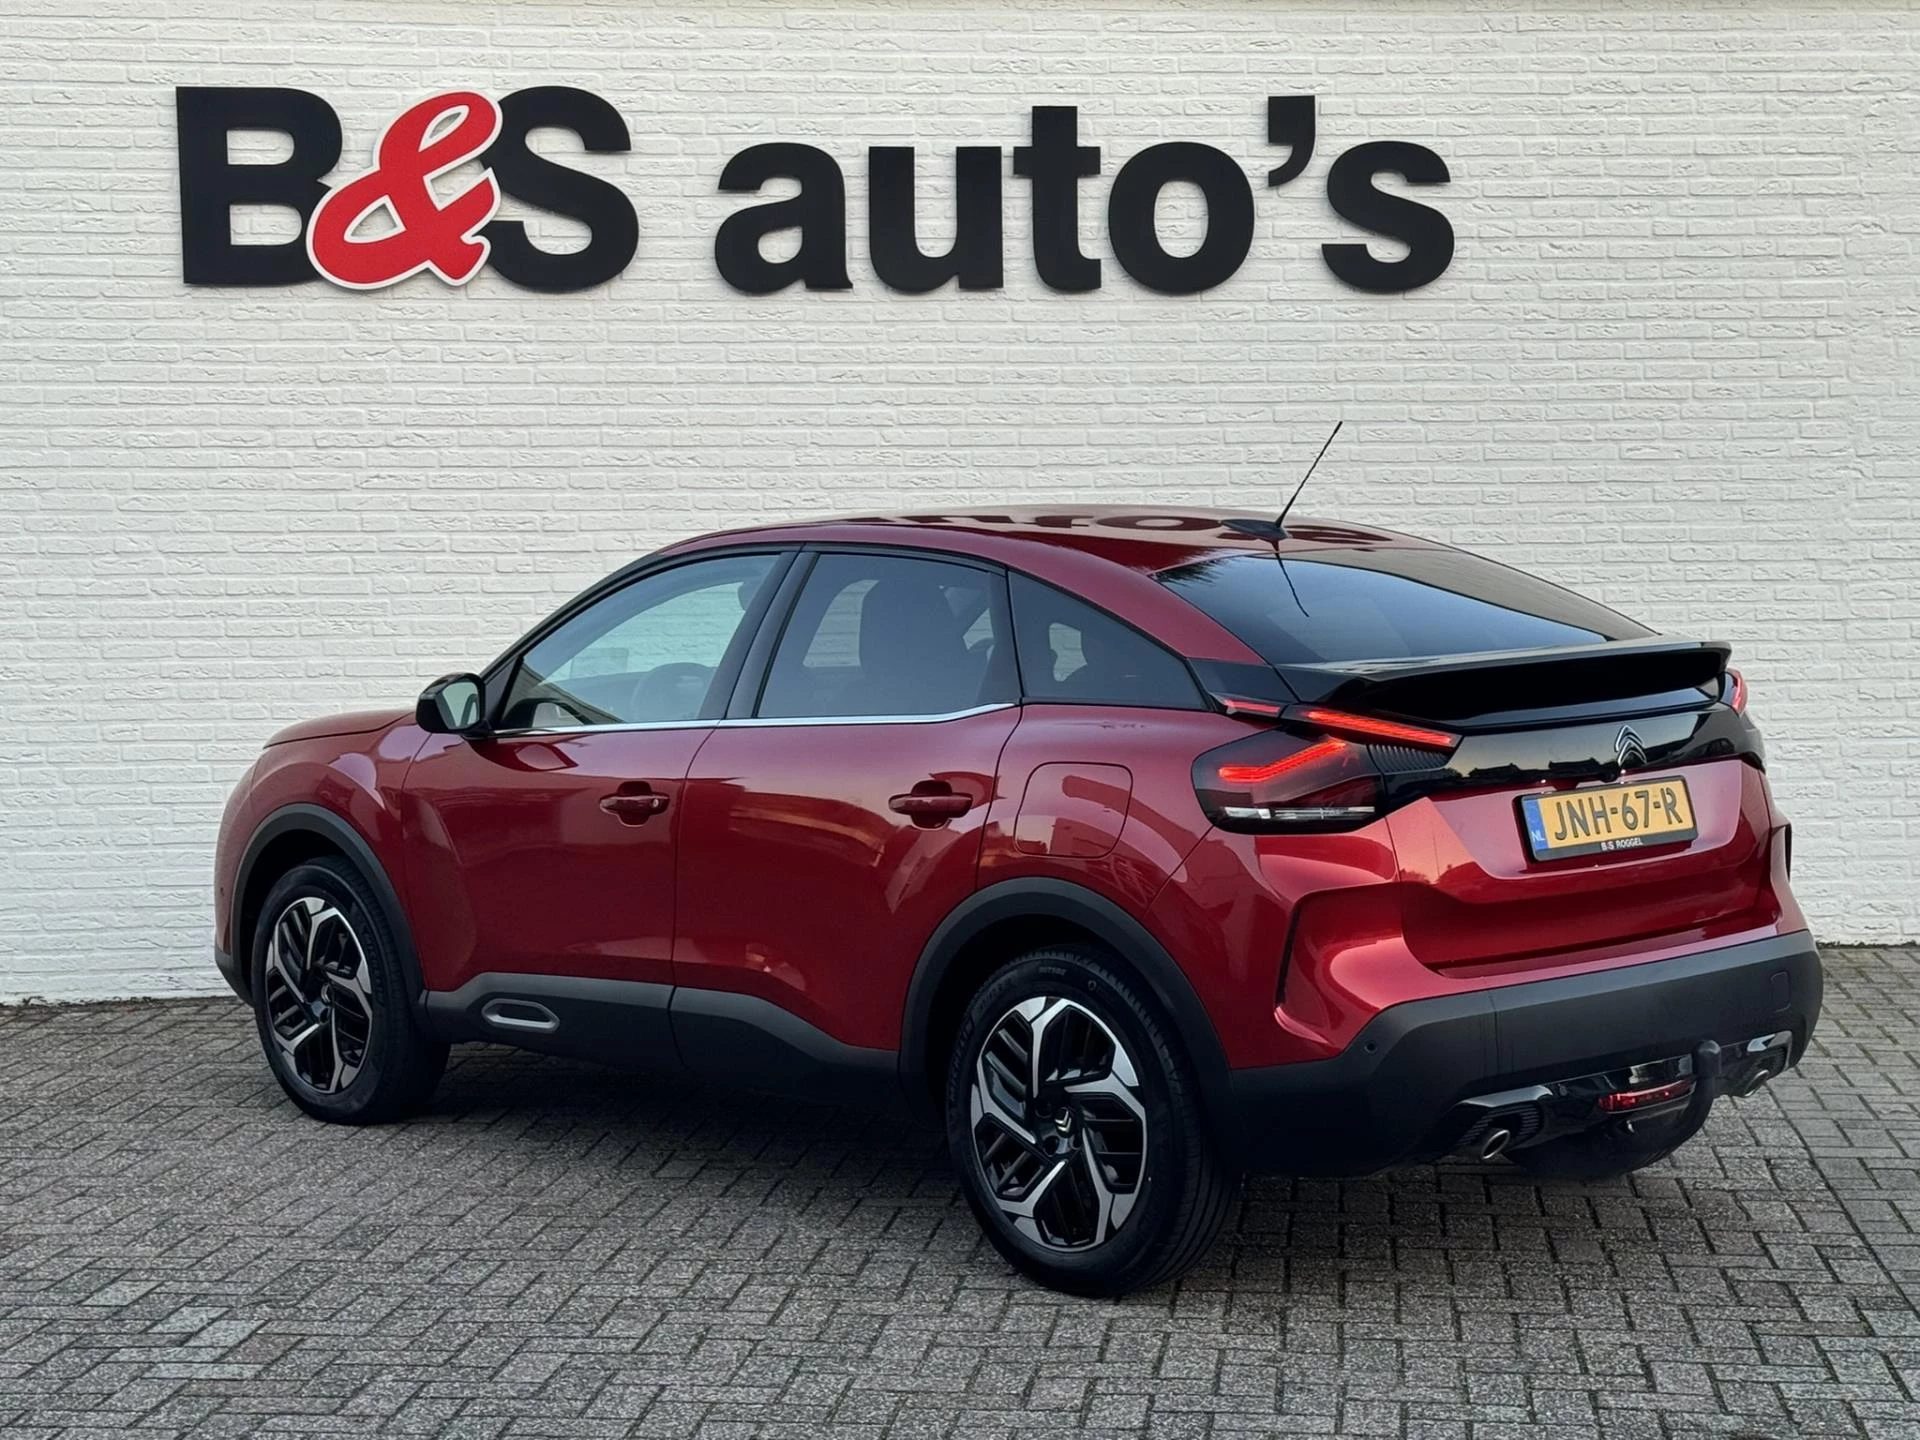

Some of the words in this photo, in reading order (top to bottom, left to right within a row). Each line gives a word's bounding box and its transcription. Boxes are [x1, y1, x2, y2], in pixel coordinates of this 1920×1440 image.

[176, 85, 638, 292] B&S
[714, 95, 1455, 295] auto's
[1531, 829, 1545, 843] NL
[1554, 787, 1683, 841] JNH-67-R
